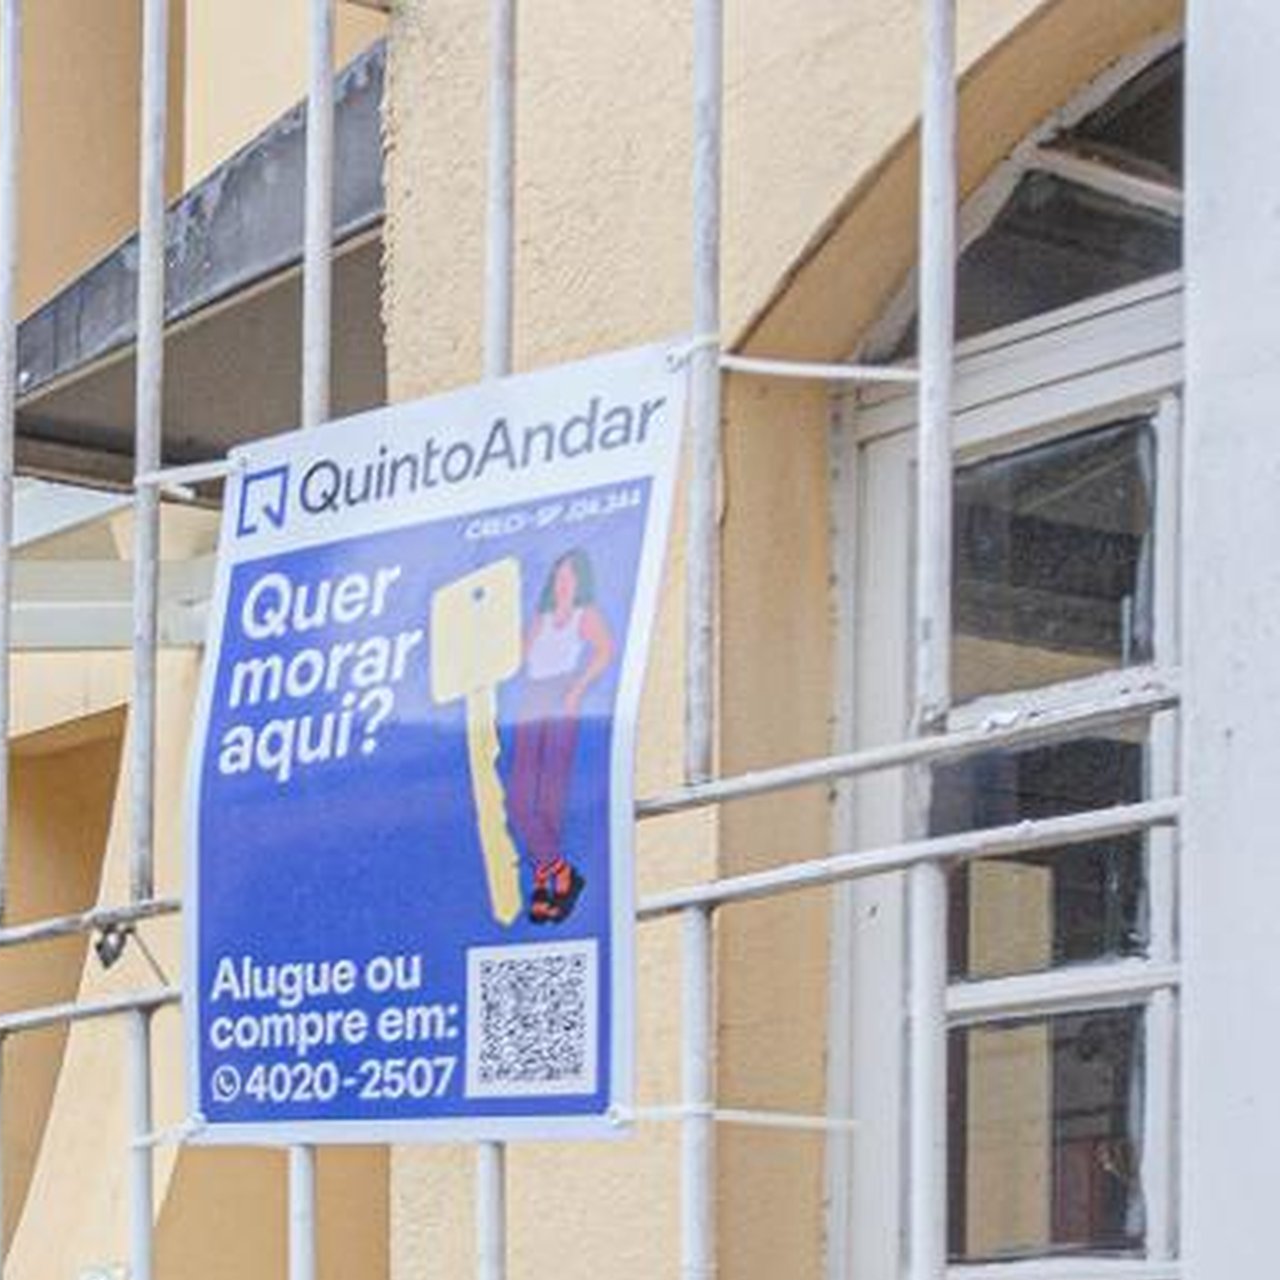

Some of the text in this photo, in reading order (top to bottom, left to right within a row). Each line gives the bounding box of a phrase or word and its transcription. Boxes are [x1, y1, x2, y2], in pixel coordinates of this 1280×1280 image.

[299, 396, 667, 515] QuintoAndar
[242, 565, 402, 640] Quer
[229, 629, 424, 710] morar
[219, 686, 395, 784] aqui?
[210, 954, 422, 1008] Alugue ou
[209, 1003, 459, 1056] compre em:
[245, 1056, 458, 1101] 4020-2507
